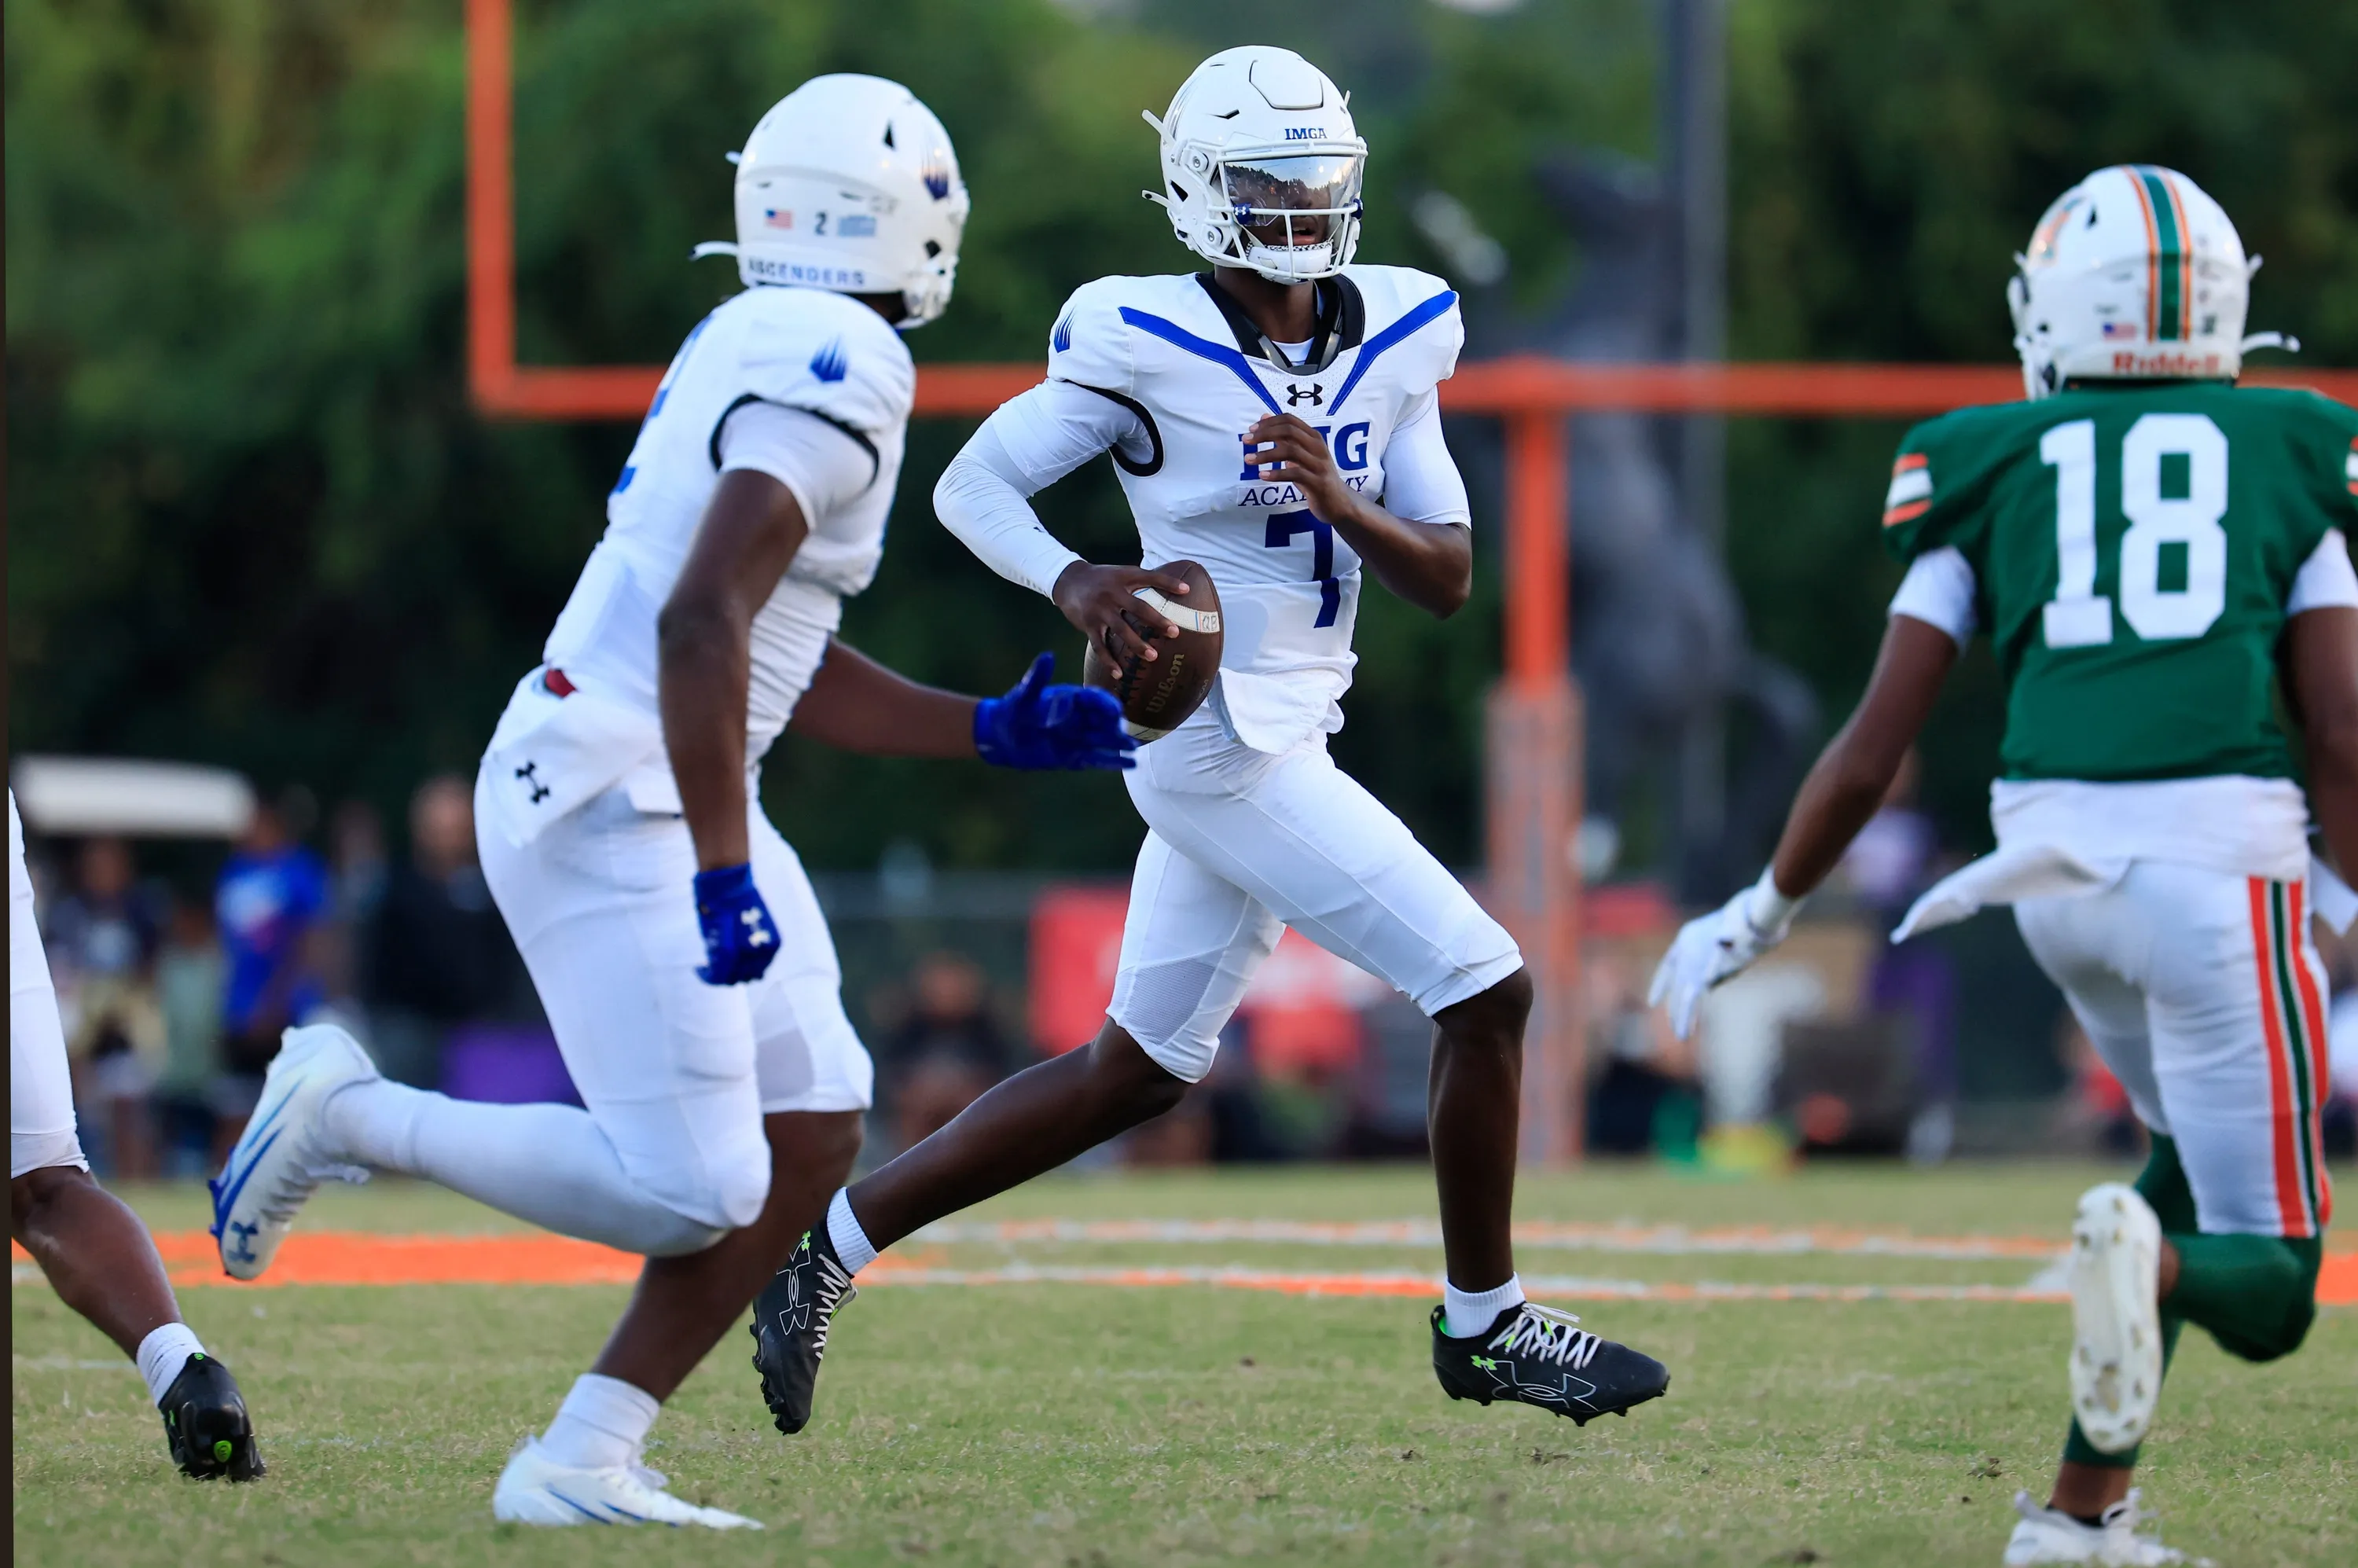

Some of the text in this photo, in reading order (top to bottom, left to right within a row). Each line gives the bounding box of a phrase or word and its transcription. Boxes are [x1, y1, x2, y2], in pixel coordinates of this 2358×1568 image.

[1284, 127, 1328, 140] IMGA
[814, 212, 826, 236] 2
[748, 258, 864, 285] ASCENDERS
[1238, 422, 1370, 480] IG
[1238, 476, 1368, 506] ACAY
[2040, 413, 2228, 649] 18
[1265, 509, 1341, 629] 7
[1146, 654, 1185, 713] Wilson
